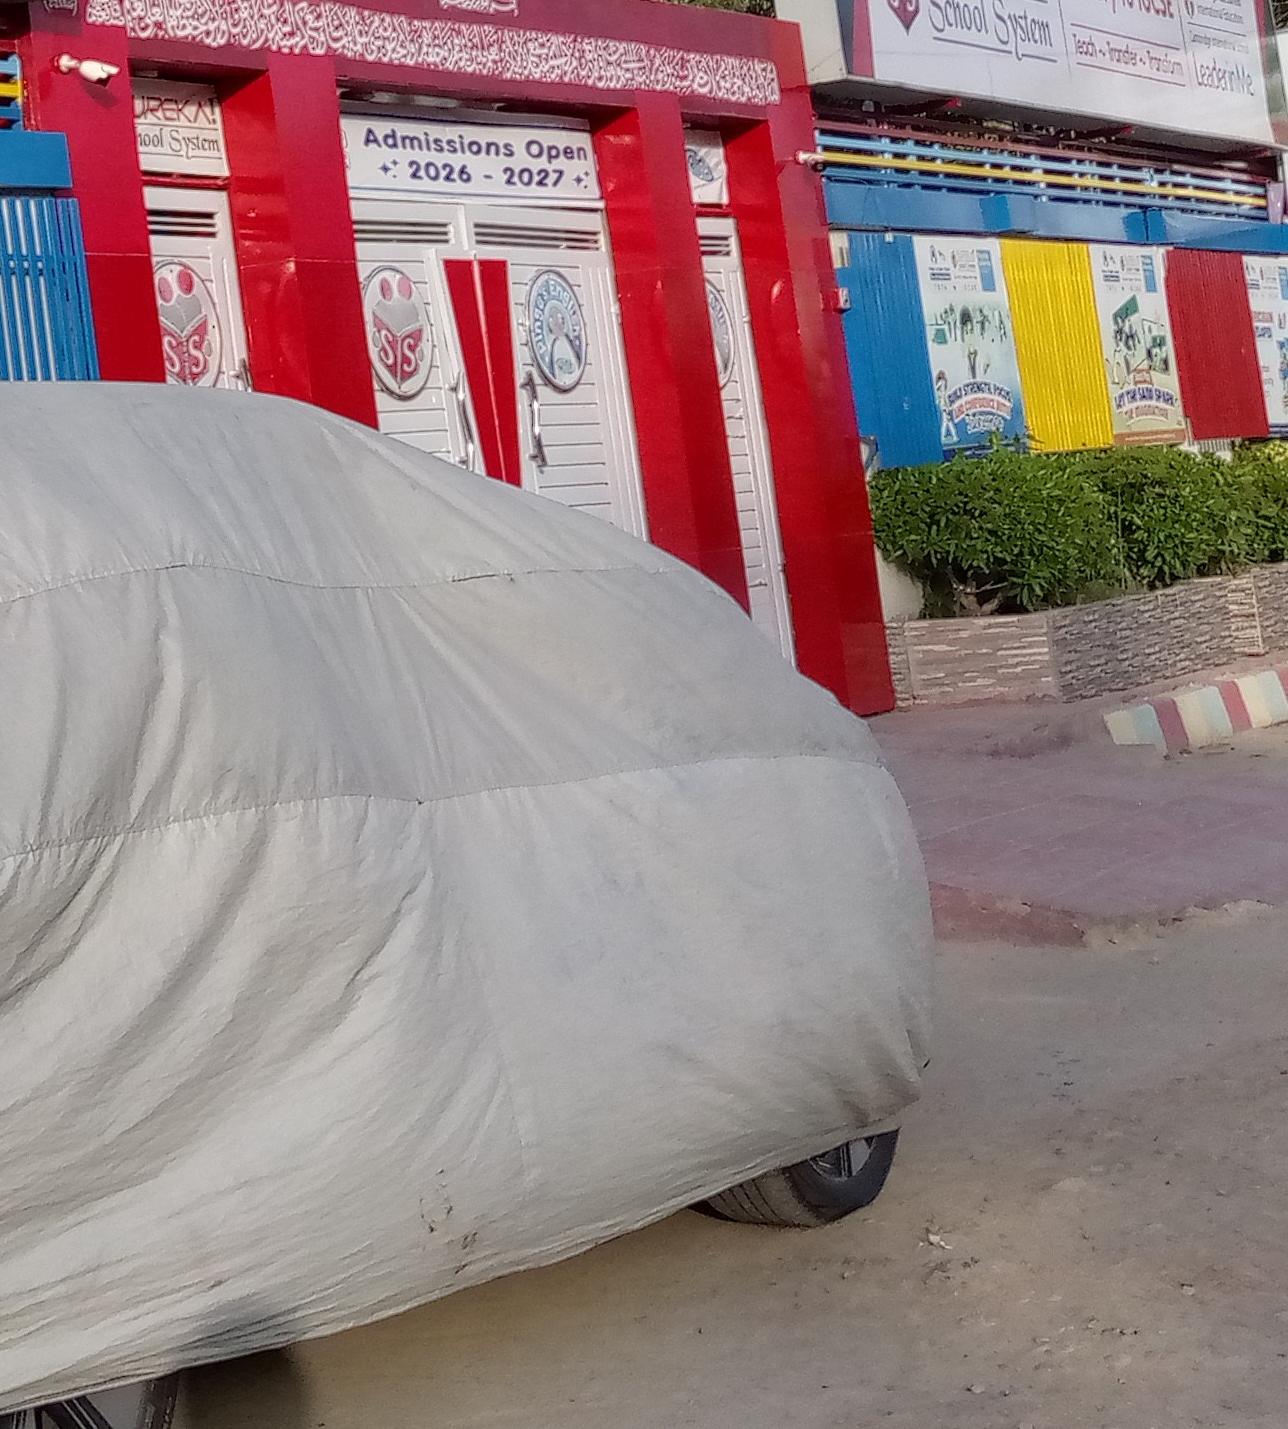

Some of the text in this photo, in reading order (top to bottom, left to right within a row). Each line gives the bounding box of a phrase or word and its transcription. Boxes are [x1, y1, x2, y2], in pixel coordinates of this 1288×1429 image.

[134, 95, 217, 125] UREKA!
[169, 129, 220, 159] System
[364, 127, 588, 163] Admissions Open
[408, 160, 472, 183] 2026
[503, 167, 565, 188] 2027
